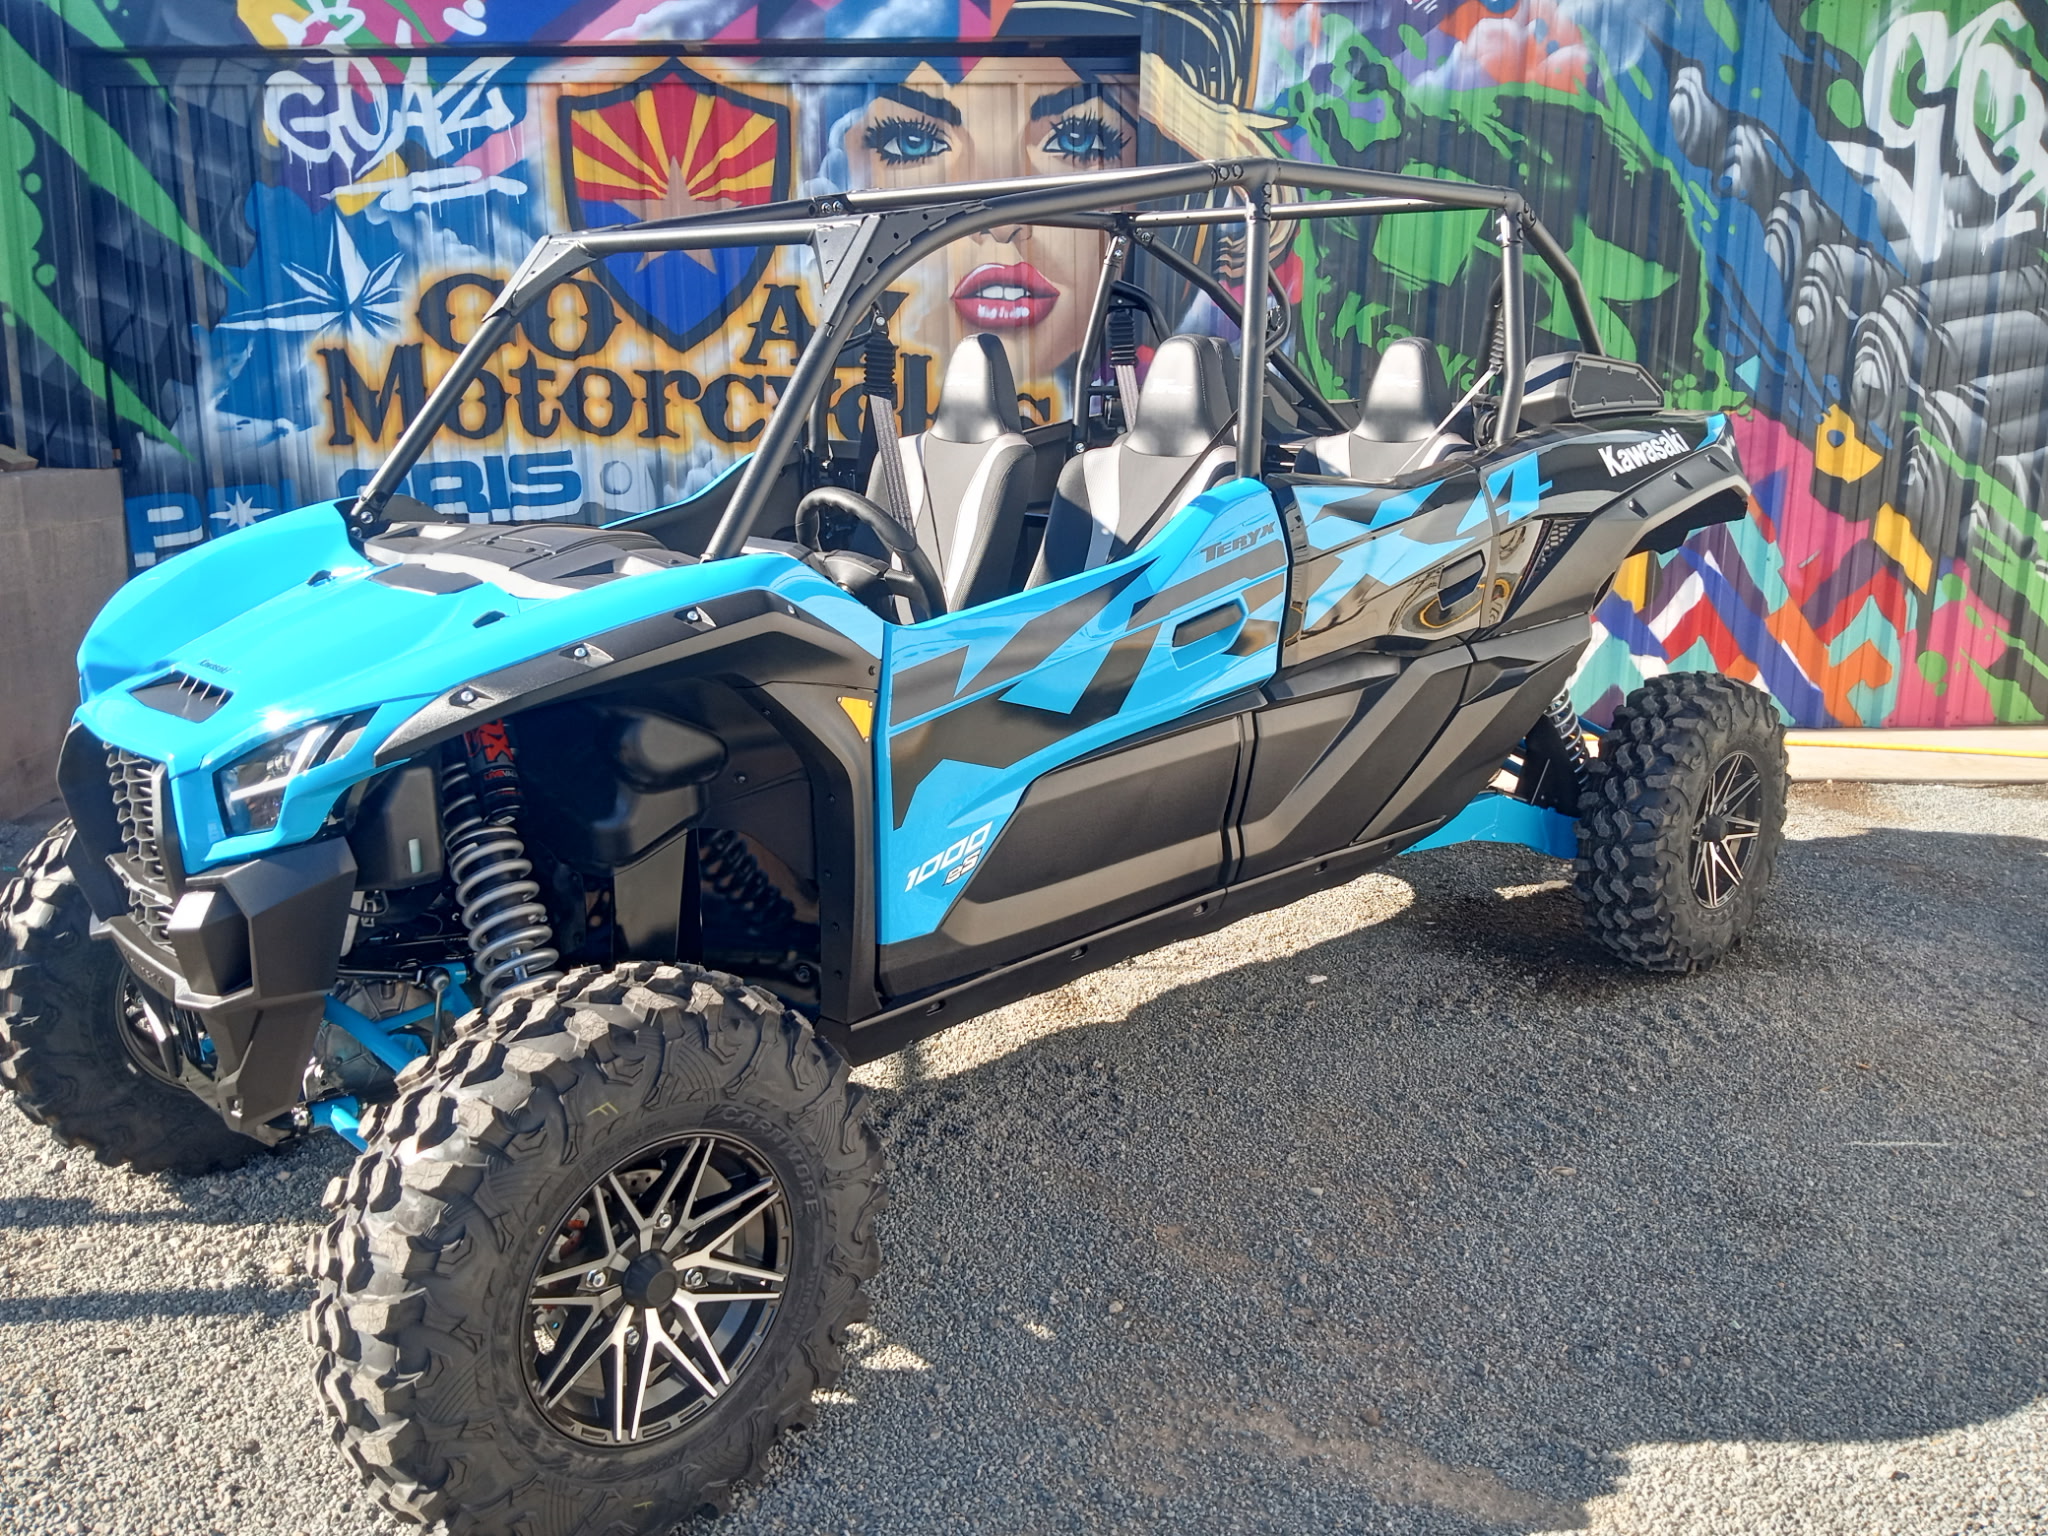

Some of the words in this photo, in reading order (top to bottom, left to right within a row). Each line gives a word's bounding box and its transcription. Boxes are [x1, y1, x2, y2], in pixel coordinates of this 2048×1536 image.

[1598, 427, 1691, 478] Kawasaki
[1200, 521, 1276, 563] TERYX
[904, 820, 993, 893] 1000
